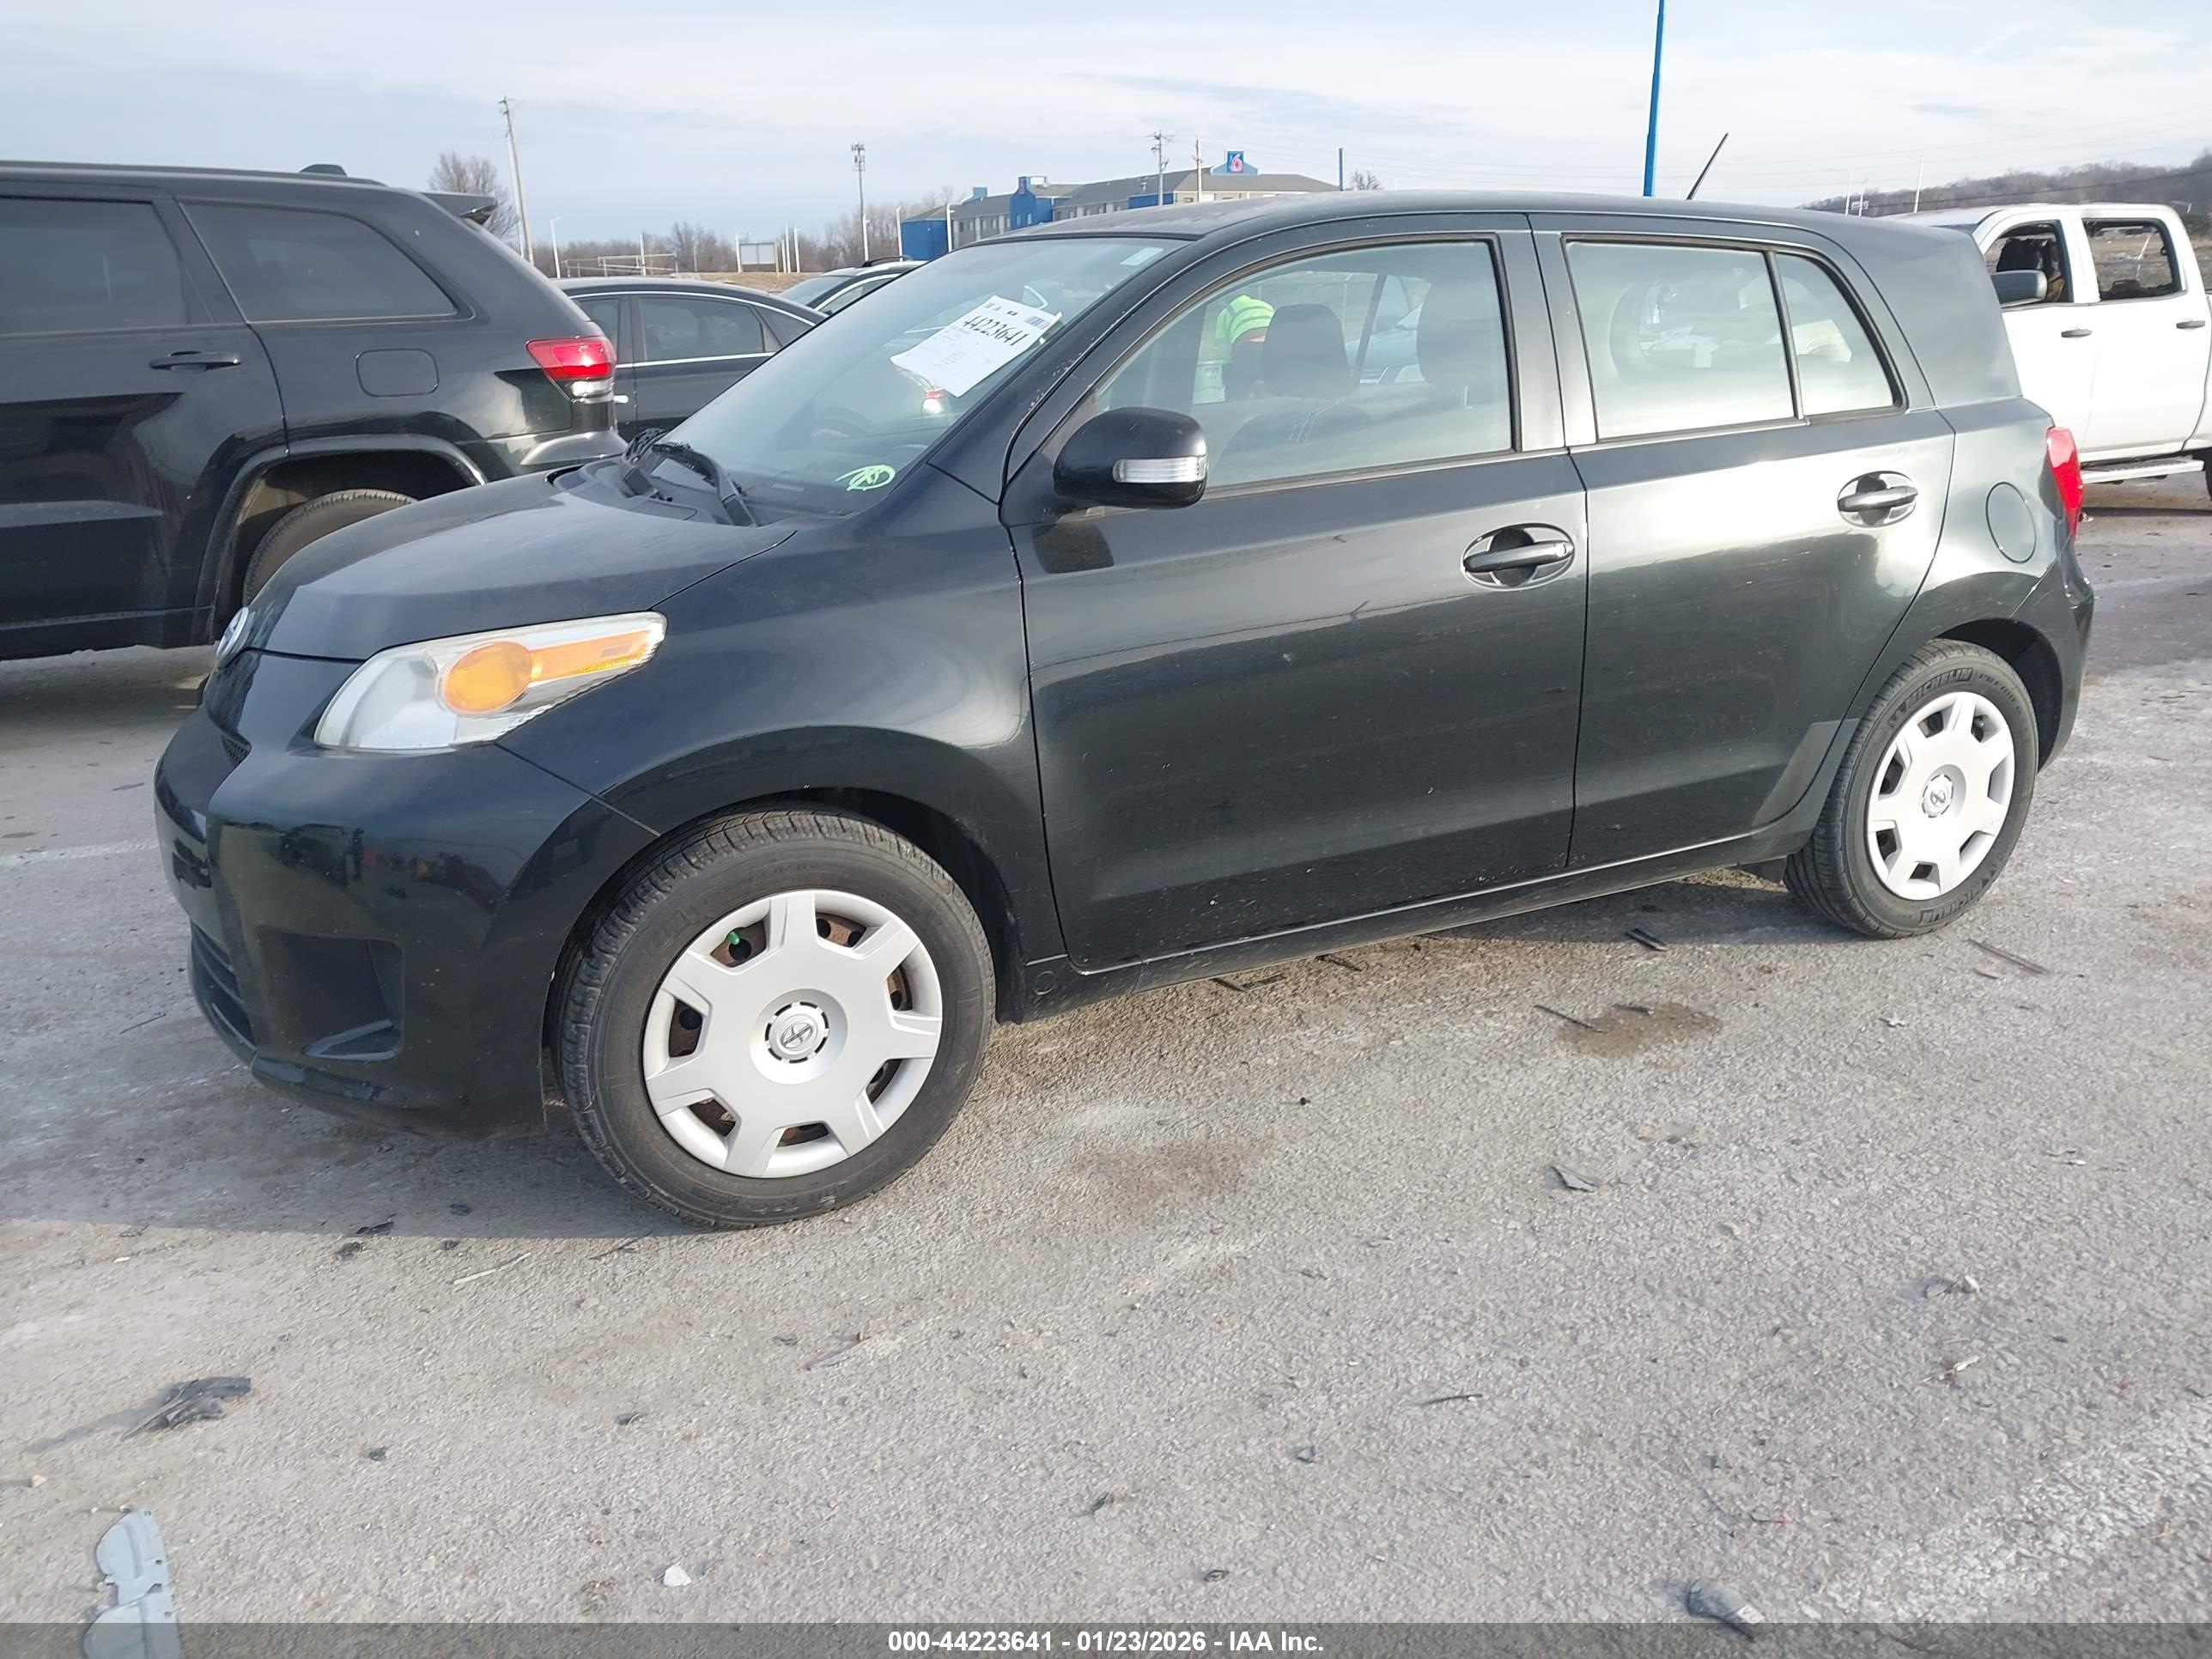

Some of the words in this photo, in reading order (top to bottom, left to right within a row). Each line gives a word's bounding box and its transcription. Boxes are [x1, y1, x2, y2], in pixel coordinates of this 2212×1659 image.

[1231, 153, 1243, 173] 6
[963, 315, 1030, 346] 44223641
[1904, 667, 1973, 710] MICHELIN
